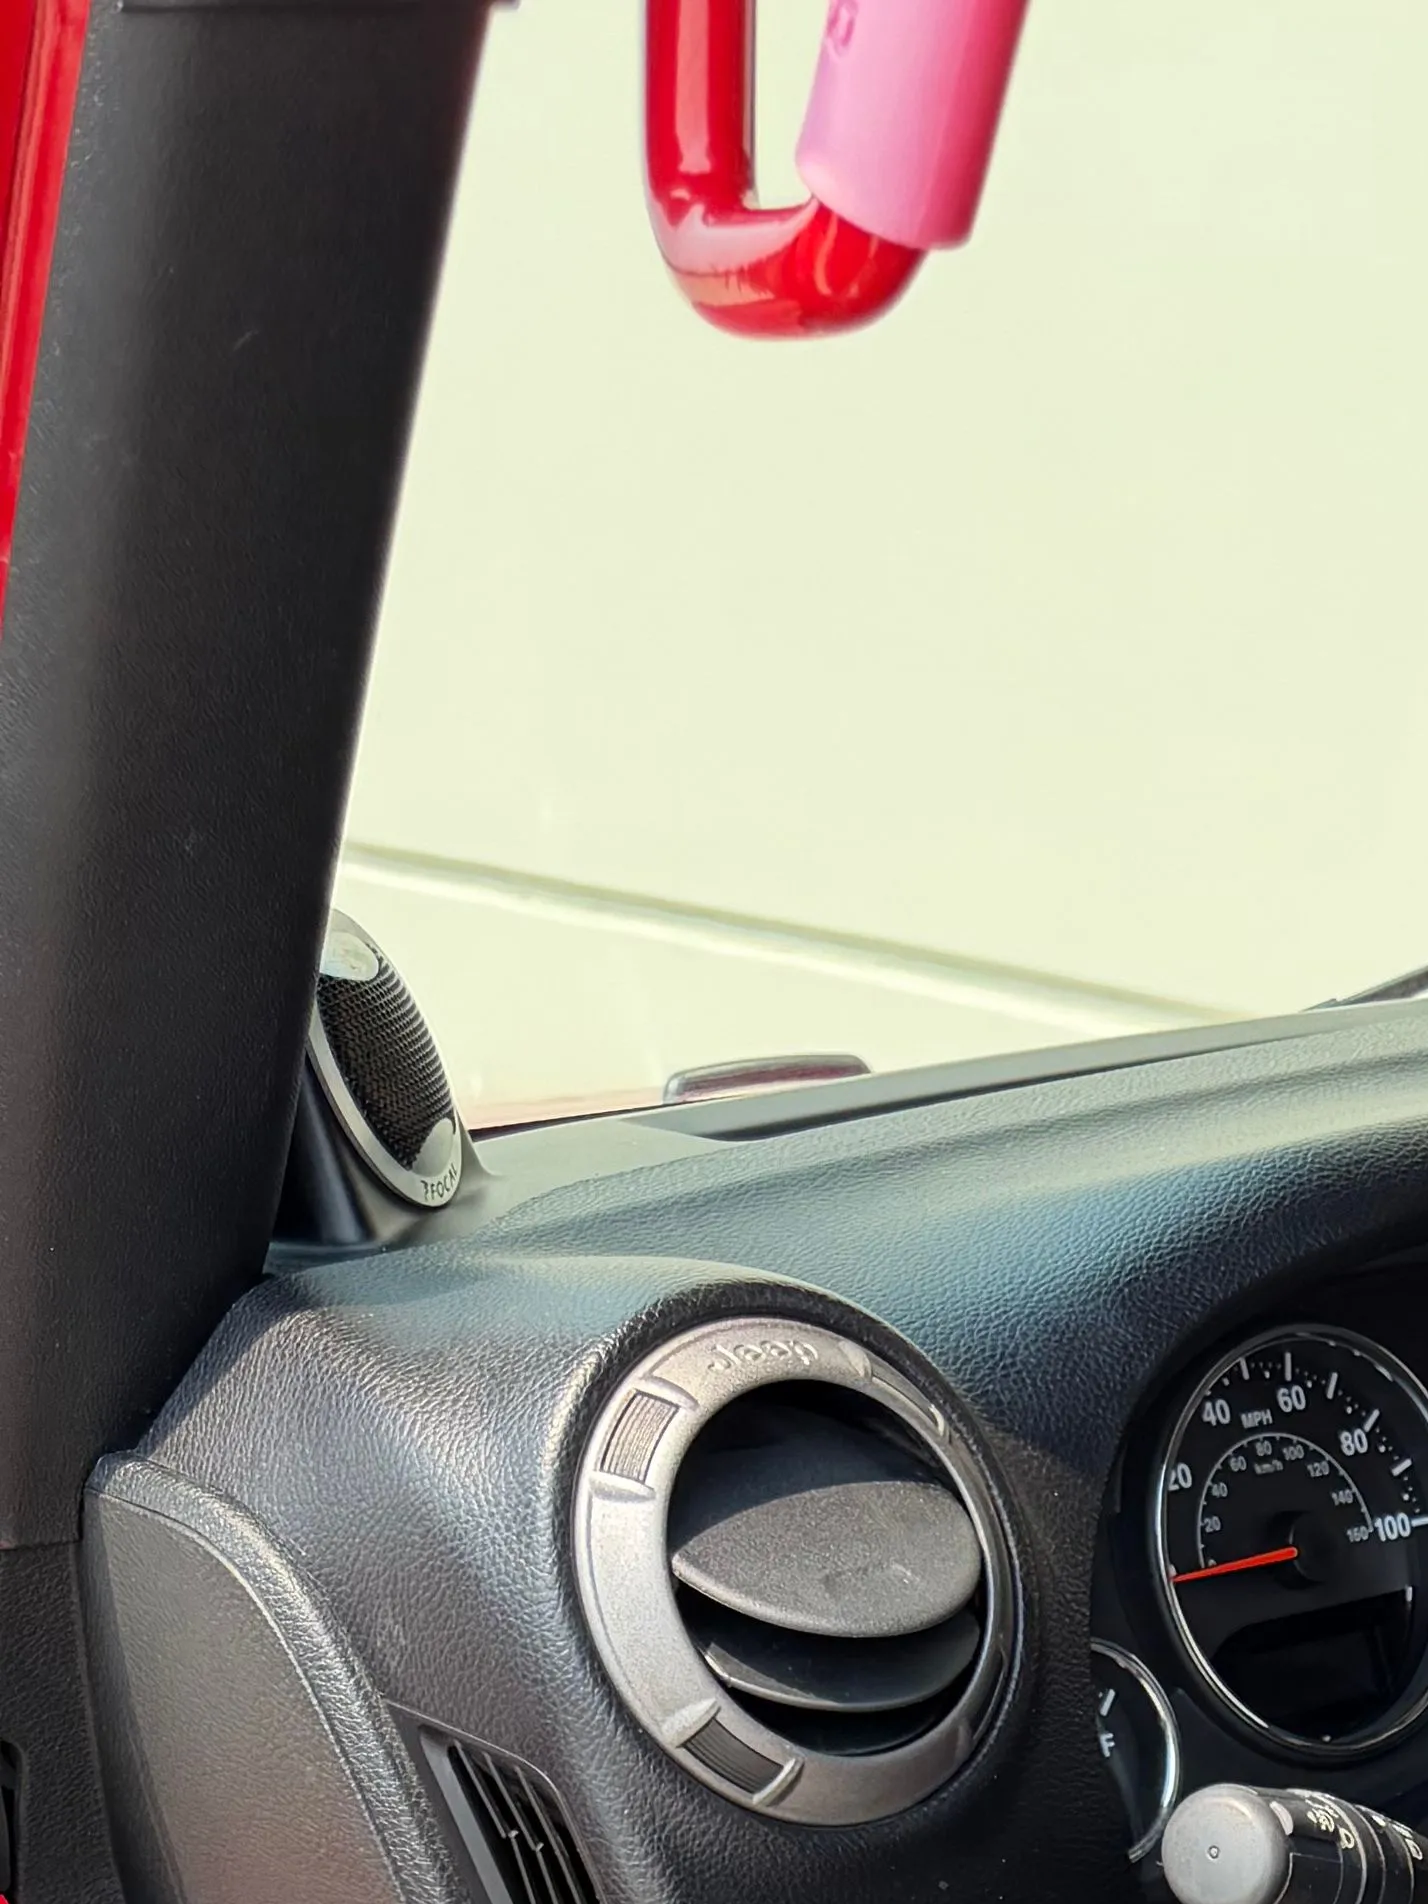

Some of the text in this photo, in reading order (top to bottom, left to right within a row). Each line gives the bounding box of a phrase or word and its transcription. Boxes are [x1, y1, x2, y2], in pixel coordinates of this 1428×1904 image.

[430, 1163, 457, 1200] FOCAL
[707, 1340, 818, 1371] Jeep
[1277, 1384, 1306, 1413] 60
[1202, 1398, 1231, 1427] 40
[1240, 1408, 1273, 1429] MPH
[1283, 1444, 1305, 1461] 100
[1340, 1428, 1369, 1456] 80
[1168, 1462, 1192, 1491] 20
[1230, 1455, 1247, 1472] 60
[1307, 1460, 1330, 1477] 120
[1211, 1482, 1228, 1498] 40
[1332, 1489, 1353, 1506] 140
[1203, 1516, 1221, 1533] 20
[1374, 1512, 1411, 1542] 100
[1096, 1732, 1116, 1758] F
